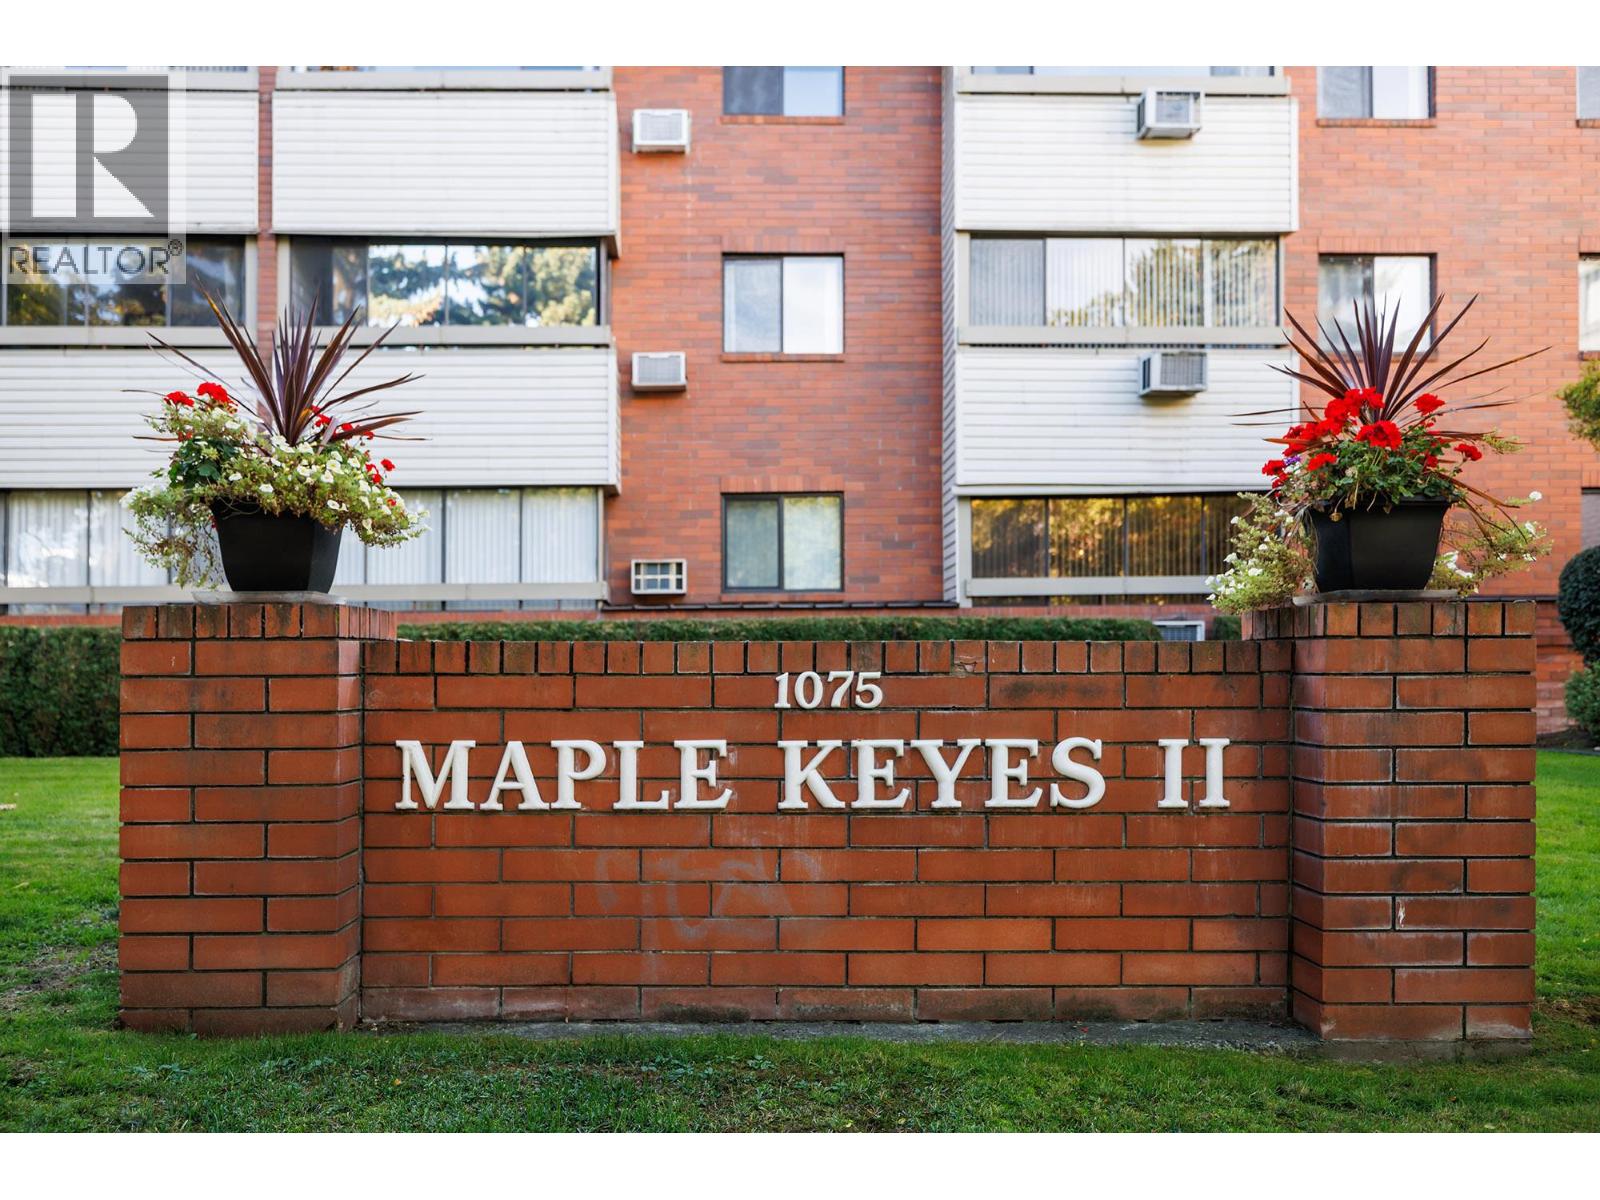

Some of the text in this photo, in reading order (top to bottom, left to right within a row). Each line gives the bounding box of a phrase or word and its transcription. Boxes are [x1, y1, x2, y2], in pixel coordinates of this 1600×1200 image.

[774, 670, 884, 710] 1075
[395, 737, 1231, 811] MAPLE KEYES II
